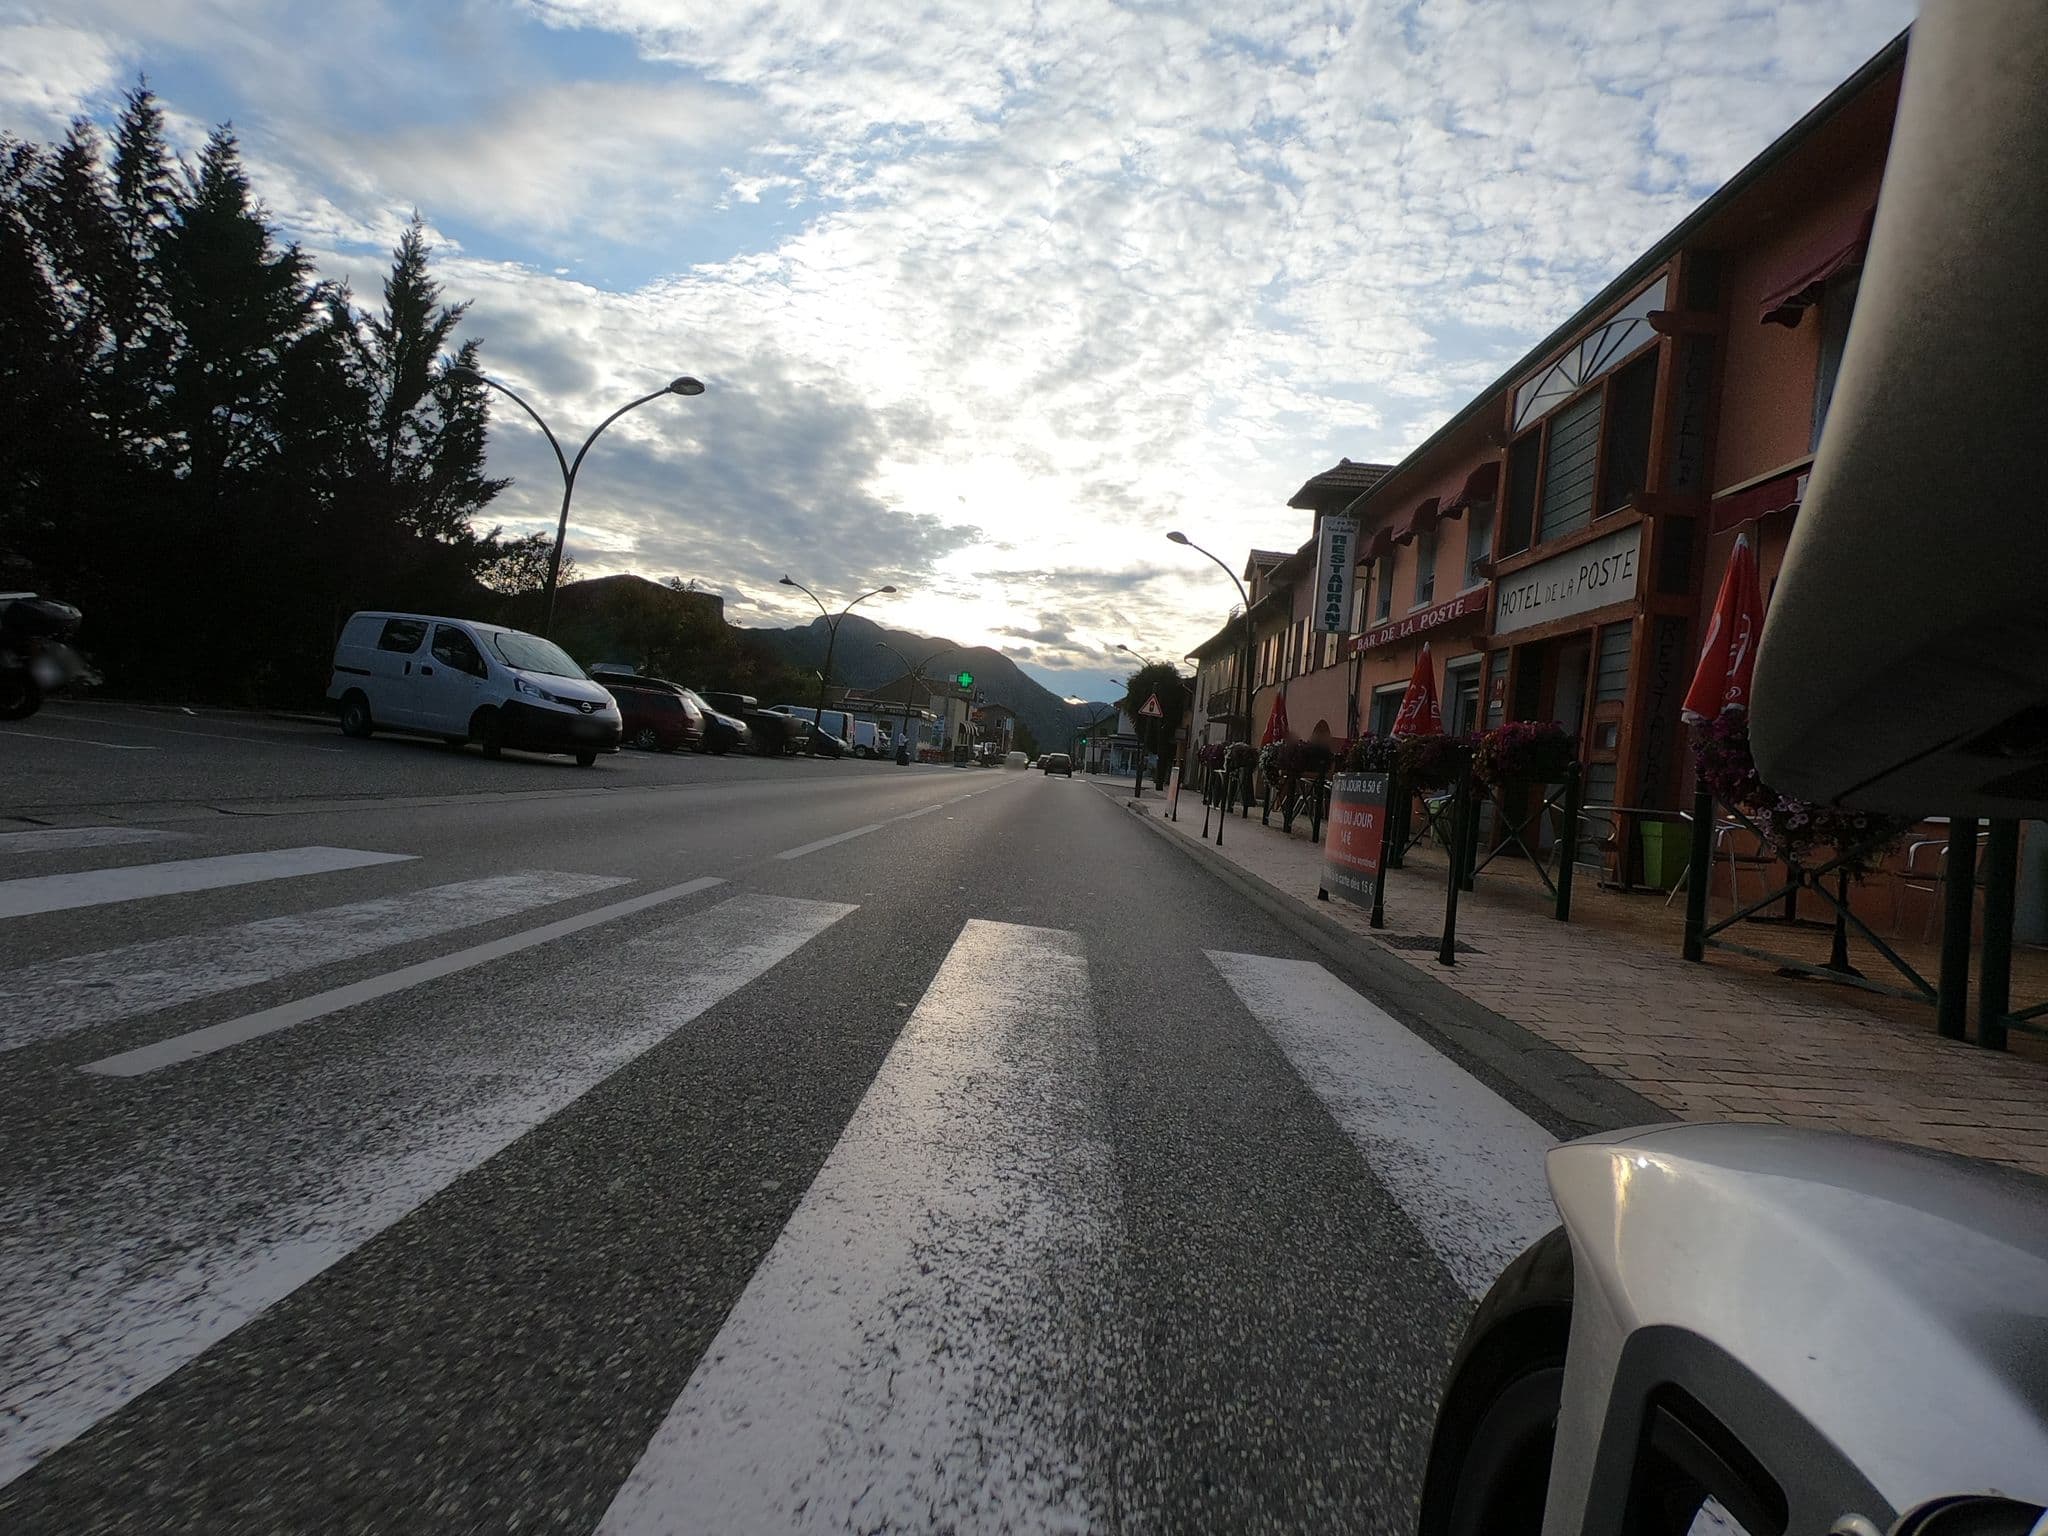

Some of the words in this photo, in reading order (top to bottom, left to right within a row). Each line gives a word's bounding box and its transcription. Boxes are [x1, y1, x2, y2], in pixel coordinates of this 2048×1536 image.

[1325, 535, 1347, 631] RESTAURANT
[1500, 581, 1542, 617] HOTEL
[1545, 584, 1557, 604] DE
[1560, 579, 1574, 599] LA
[1577, 548, 1636, 596] POSTE
[1357, 634, 1376, 651] BAR
[1380, 627, 1395, 642] DE
[1400, 620, 1414, 637] LA
[1420, 599, 1466, 629] POSTE
[1347, 779, 1361, 792] JOUR
[1362, 780, 1375, 793] 9.50
[1376, 781, 1382, 794] €
[1343, 810, 1352, 825] DU
[1353, 812, 1373, 829] JOUR
[1361, 880, 1368, 893] 15
[1368, 882, 1374, 896] €
